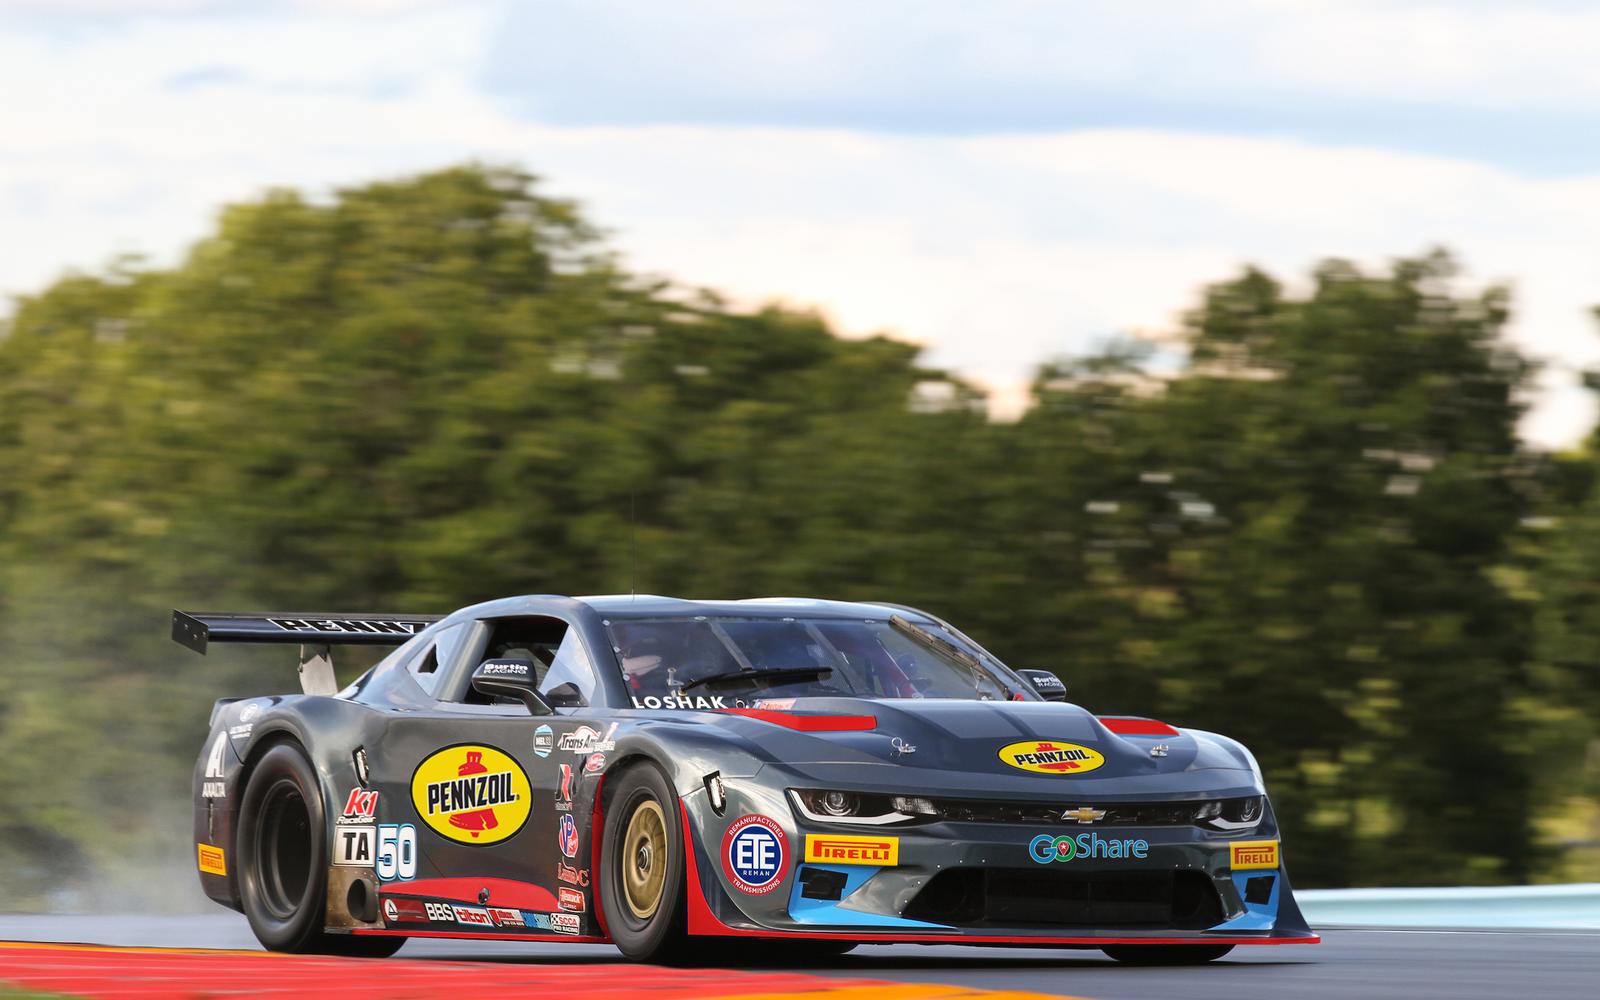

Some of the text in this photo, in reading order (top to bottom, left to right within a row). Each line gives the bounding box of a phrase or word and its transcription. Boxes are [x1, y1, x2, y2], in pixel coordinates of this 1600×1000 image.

[484, 663, 528, 671] Burtin
[631, 695, 728, 710] LOSHAK
[560, 733, 584, 749] Trans
[1012, 747, 1091, 766] PENNZOIL
[343, 786, 379, 817] K1
[426, 771, 517, 815] PENNZOIL
[728, 815, 784, 838] REMANUFACTURED
[342, 831, 371, 861] TA
[376, 823, 417, 882] 50
[737, 833, 775, 869] ETE
[812, 839, 892, 861] PIRELLI
[1234, 845, 1275, 865] PIRELLI
[732, 876, 782, 895] TRANSMISSIONS
[424, 902, 455, 921] BBS
[456, 907, 491, 924] tilton
[558, 916, 578, 927] SCCA
